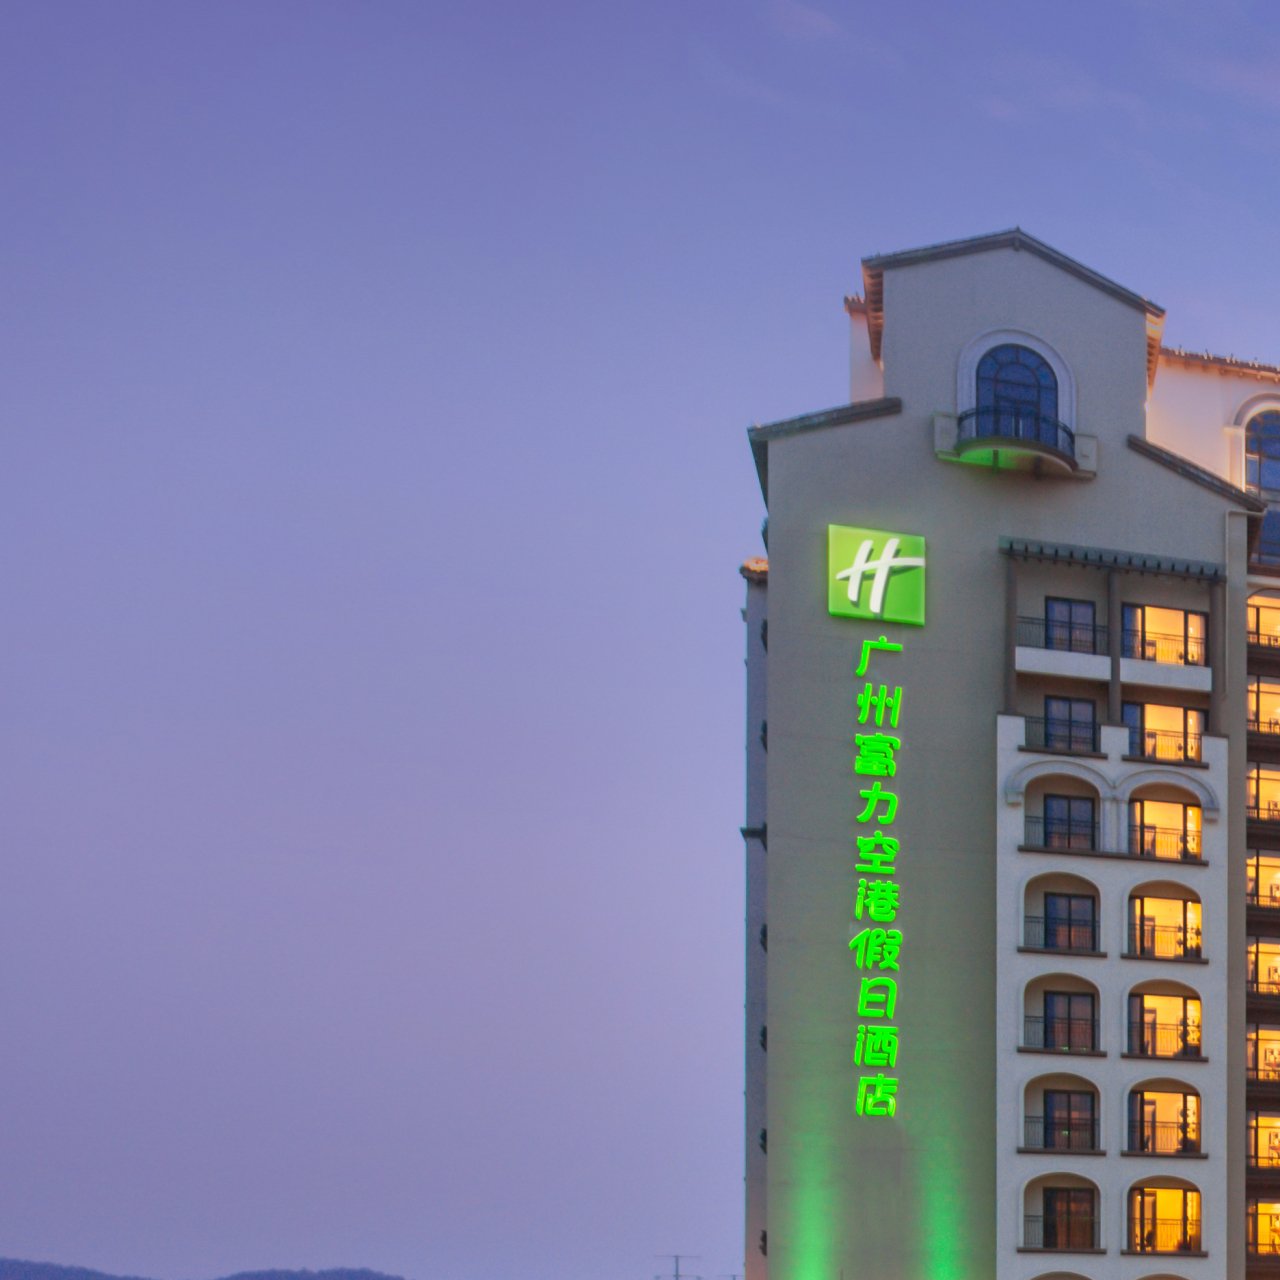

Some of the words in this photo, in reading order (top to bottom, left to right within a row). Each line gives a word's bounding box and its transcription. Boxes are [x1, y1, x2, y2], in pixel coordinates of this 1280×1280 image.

[848, 635, 904, 1118] 广州富力空港假日酒店
